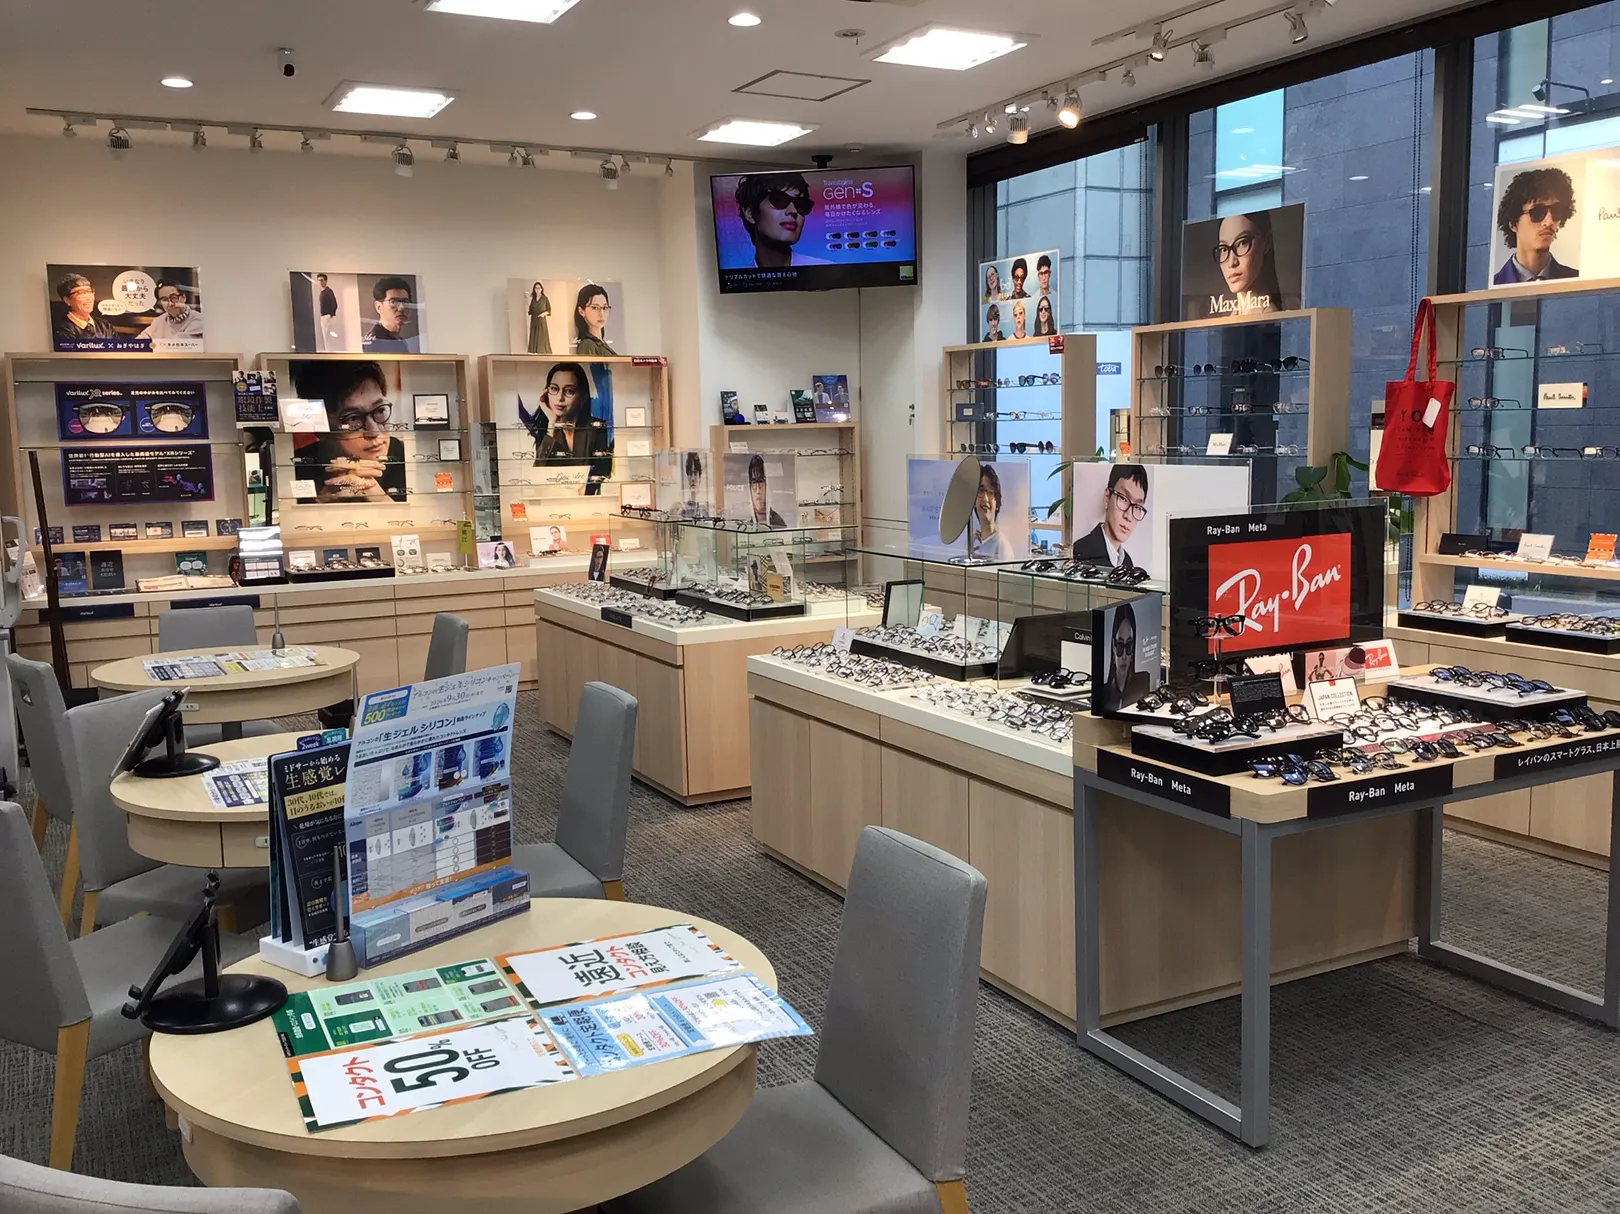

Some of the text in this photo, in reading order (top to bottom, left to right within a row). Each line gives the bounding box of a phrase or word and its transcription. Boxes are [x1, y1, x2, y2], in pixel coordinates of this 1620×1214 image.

[121, 284, 149, 292] 最から
[1207, 523, 1268, 536] Ray-Ban Meta
[364, 709, 386, 725] 500
[301, 742, 320, 750] 2week
[1130, 767, 1192, 795] Ray-Ban Meta
[1348, 780, 1416, 803] Ray-Ban Meta
[558, 949, 622, 988] 遠近
[609, 944, 649, 979] コンタクト
[624, 940, 671, 974] 見え方相談
[464, 1047, 501, 1070] OFF
[342, 1056, 386, 1110] コンタクト
